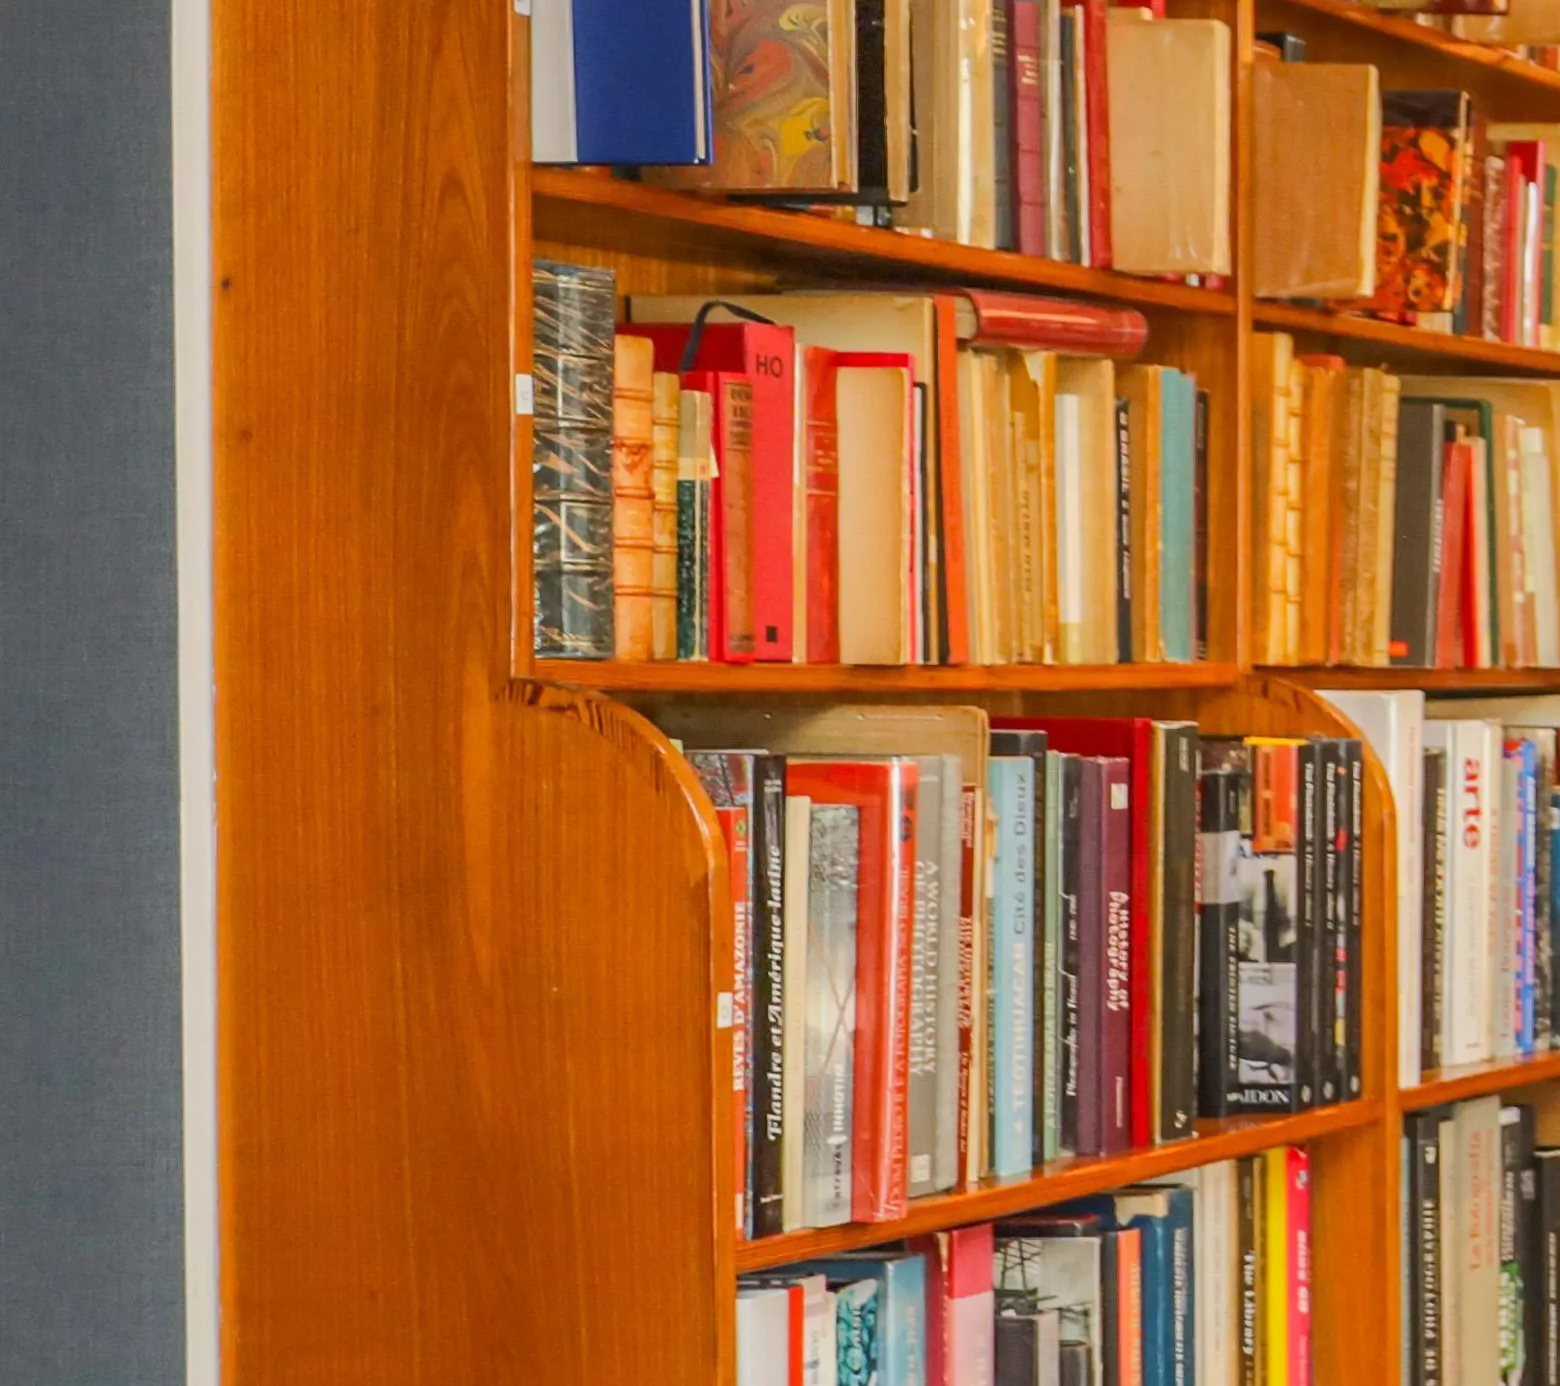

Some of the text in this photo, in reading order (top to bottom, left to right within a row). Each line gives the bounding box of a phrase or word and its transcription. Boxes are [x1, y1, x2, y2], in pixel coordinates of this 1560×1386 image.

[1463, 758, 1484, 849] arte
[925, 880, 940, 967] WORLD
[1010, 773, 1027, 1113] TEOTIHUACAN Cité des Dieux
[1108, 891, 1120, 1011] Photography
[766, 1027, 782, 1048] et
[924, 973, 939, 1073] HISTORY
[765, 1052, 783, 1141] Flandre
[1227, 1088, 1291, 1105] IDON
